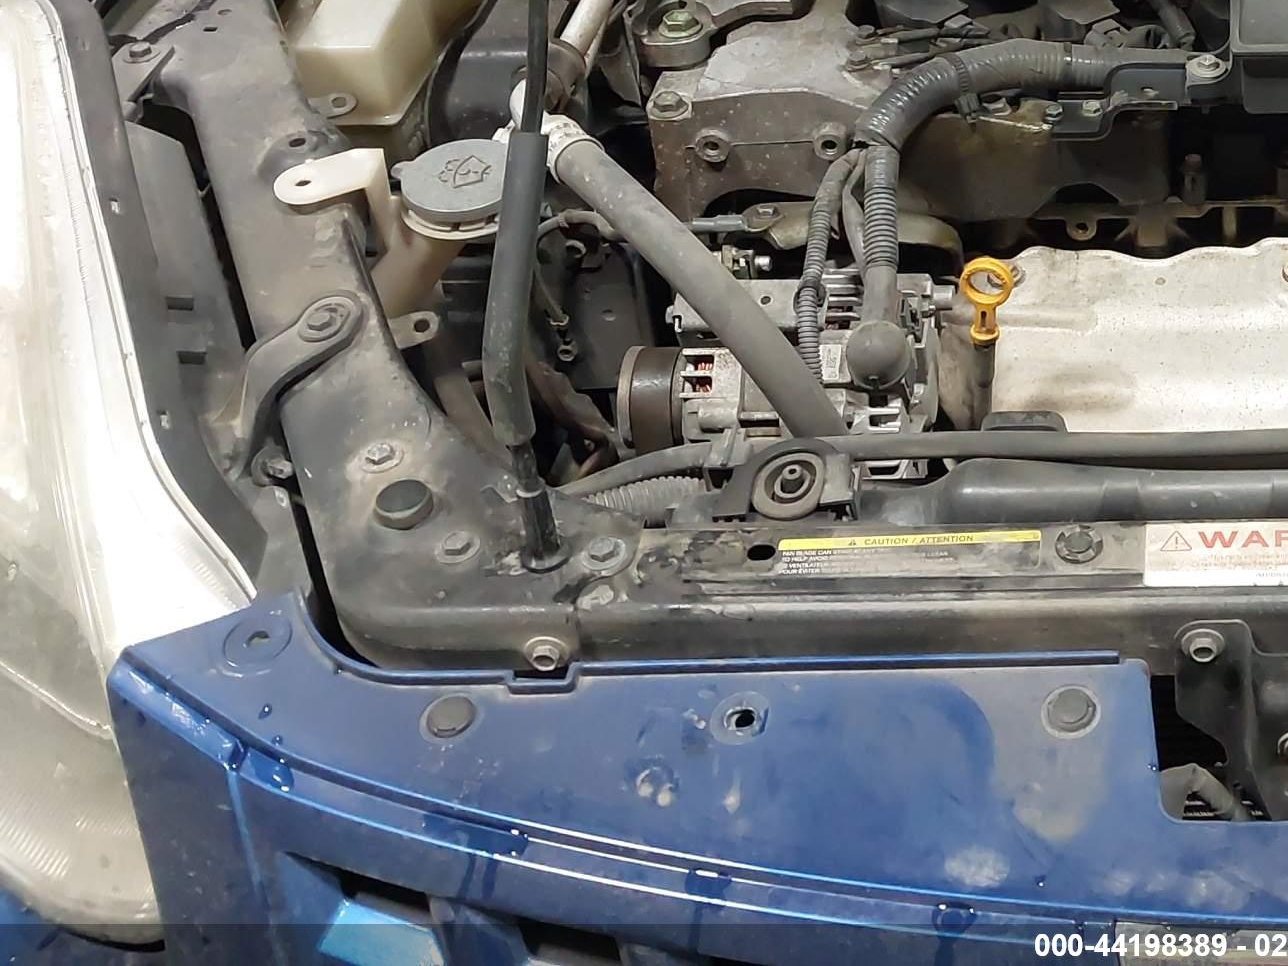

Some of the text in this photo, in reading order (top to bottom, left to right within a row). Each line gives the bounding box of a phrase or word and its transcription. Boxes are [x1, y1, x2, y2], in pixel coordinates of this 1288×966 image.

[864, 535, 975, 546] CAUTION / ATTENTION
